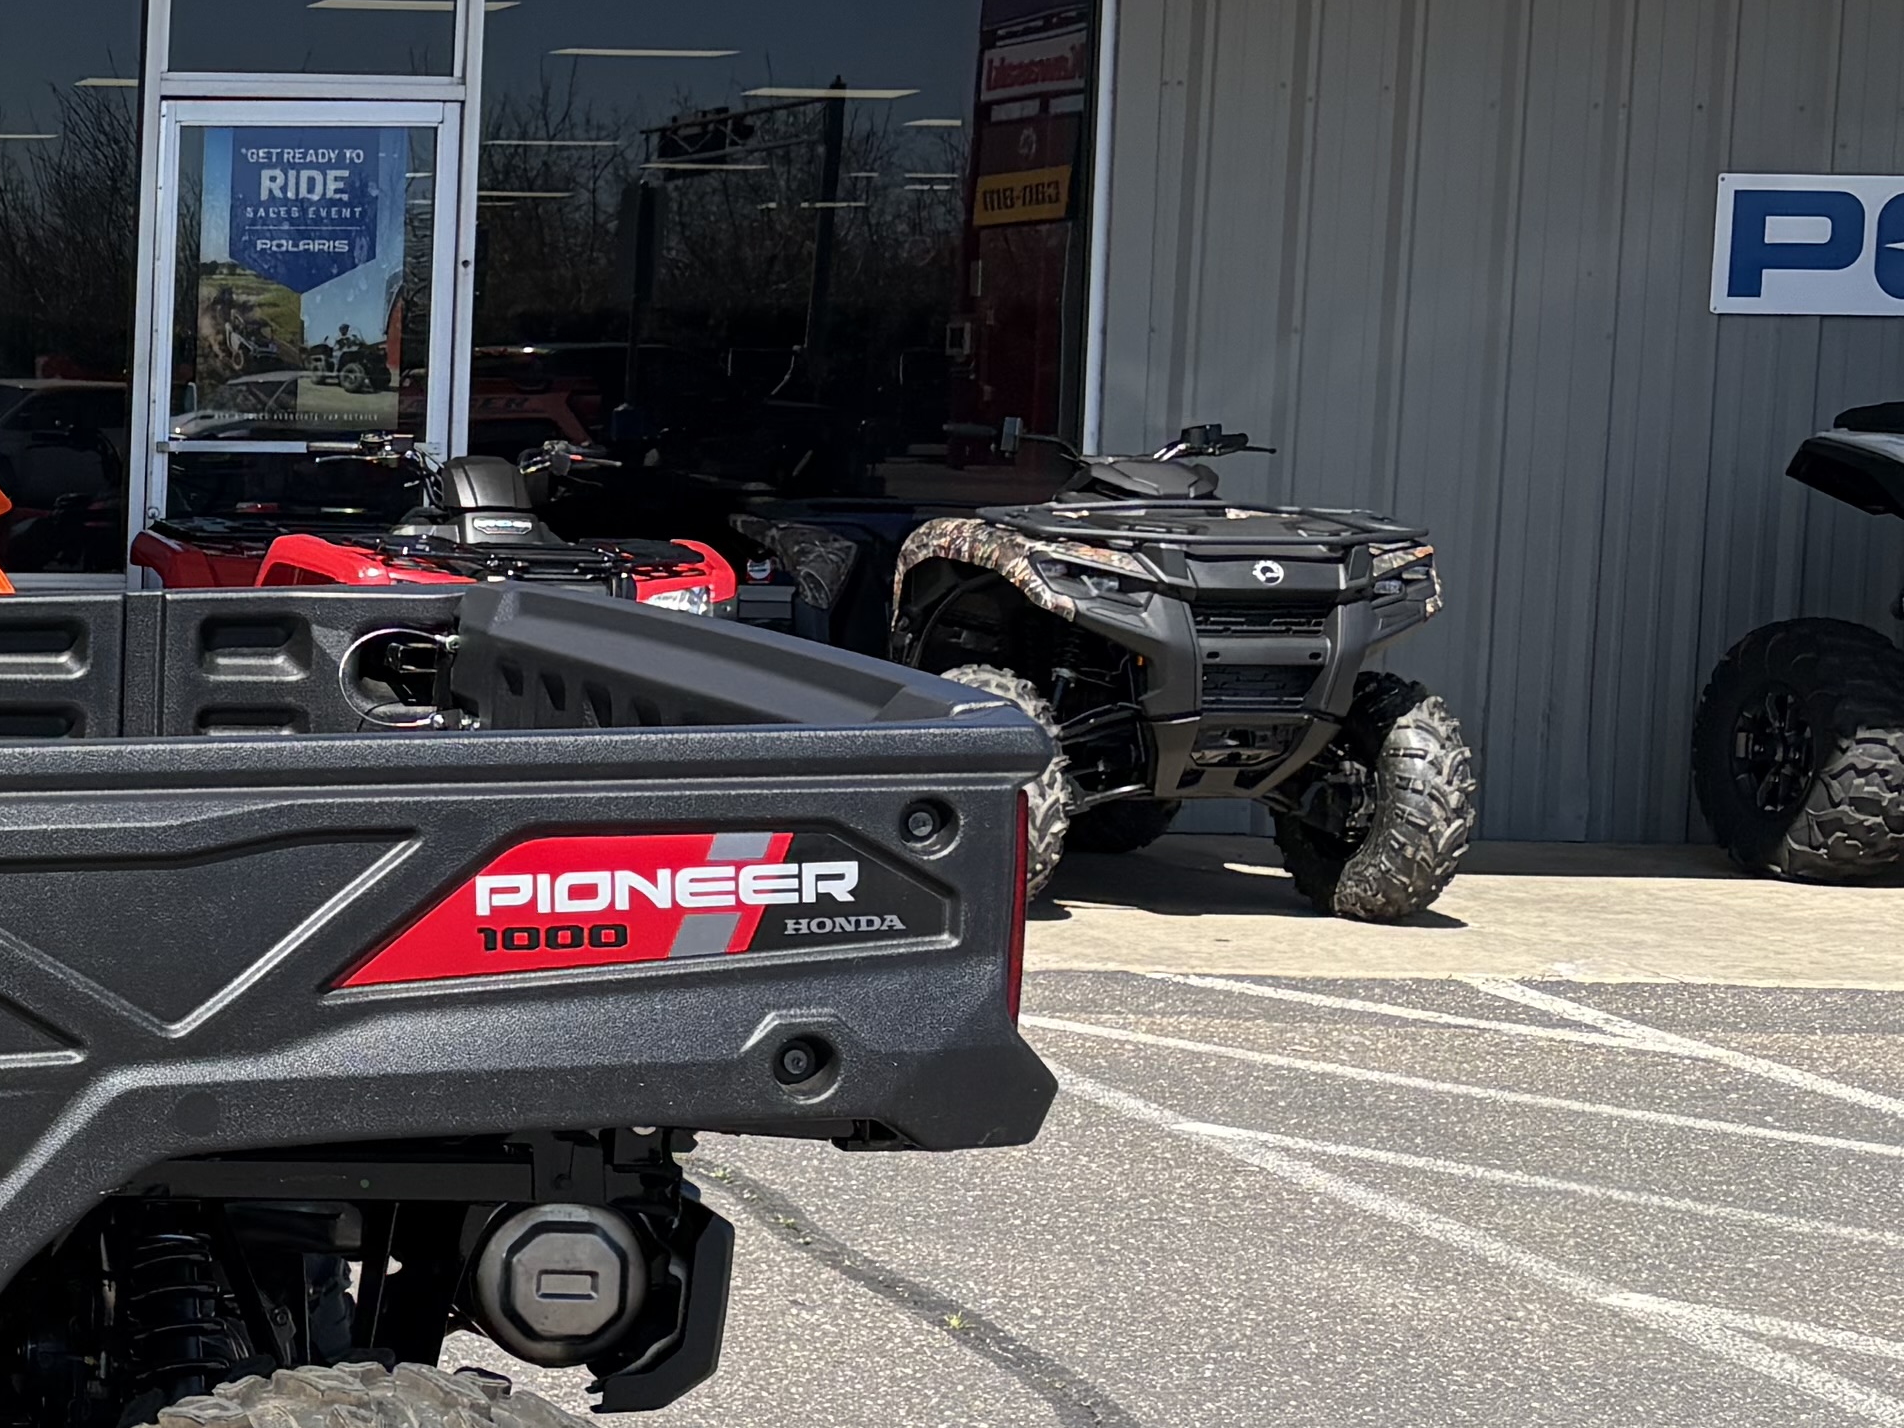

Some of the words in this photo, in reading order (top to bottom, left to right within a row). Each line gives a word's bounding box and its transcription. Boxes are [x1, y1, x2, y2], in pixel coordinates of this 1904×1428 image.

[283, 149, 339, 163] READY
[345, 149, 364, 163] TO
[260, 168, 350, 202] RIDE
[308, 207, 364, 218] EVENT
[256, 239, 350, 253] POLARIS
[475, 861, 859, 916] PIONEER
[784, 913, 906, 936] HONDA
[478, 923, 628, 952] 1000
